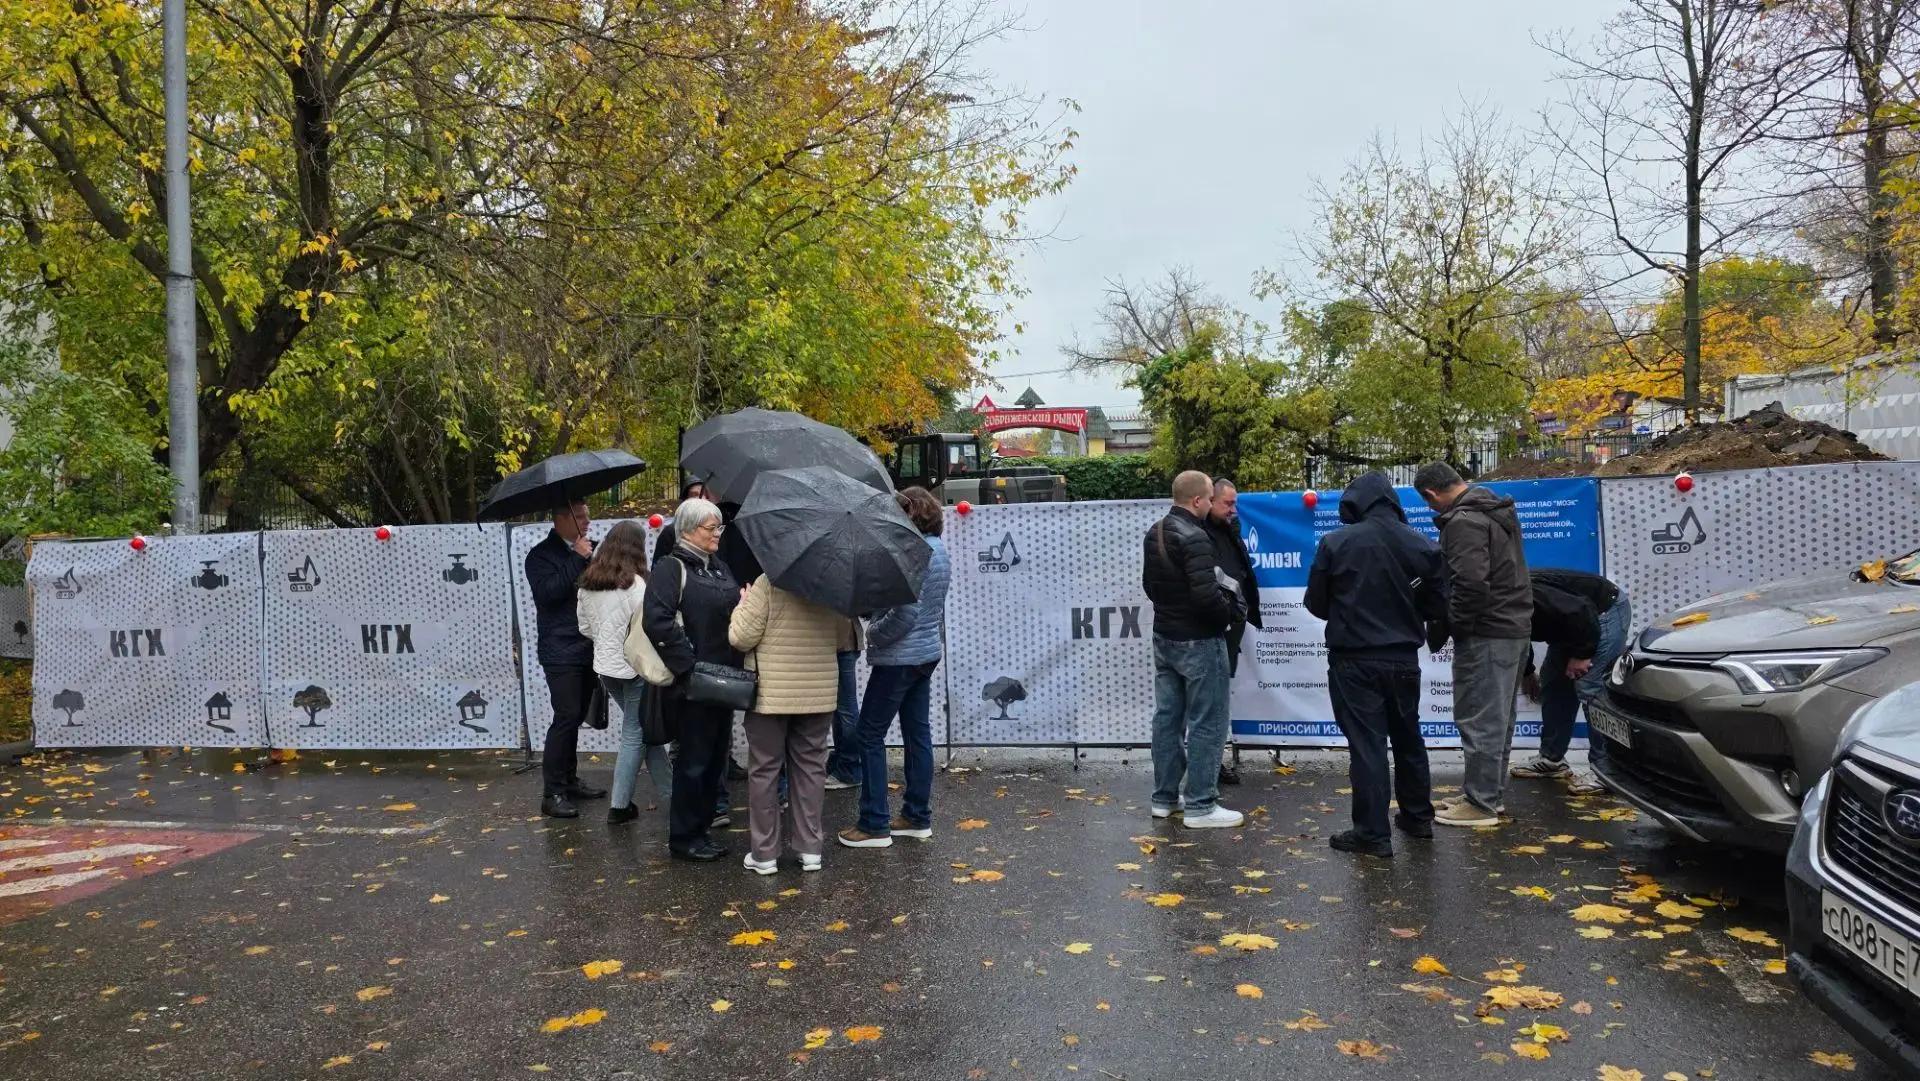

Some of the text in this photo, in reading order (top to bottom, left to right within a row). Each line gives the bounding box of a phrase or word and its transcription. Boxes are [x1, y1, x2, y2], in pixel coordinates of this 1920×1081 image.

[1053, 412, 1084, 428] РЫНОК
[1537, 500, 1552, 508] ПАО
[1261, 552, 1302, 569] МОЭК
[1071, 606, 1142, 640] КГХ
[110, 629, 166, 657] КГХ
[361, 624, 415, 654] КГХ
[1256, 649, 1315, 657] Производитель
[1258, 681, 1280, 689] Сроки
[1258, 723, 1320, 735] ПРИНОСИМ
